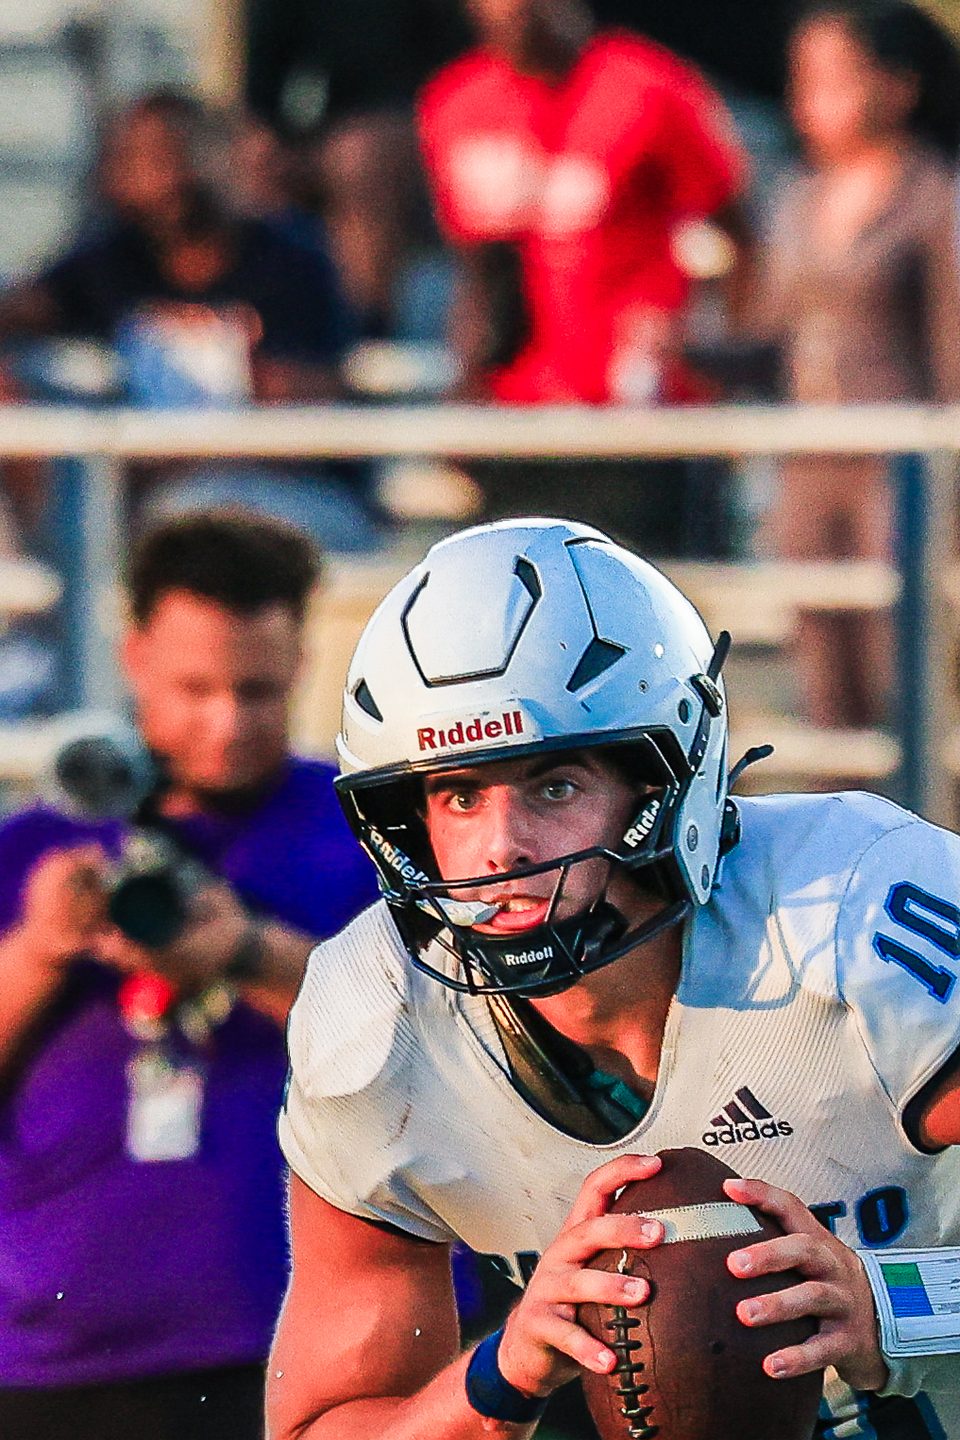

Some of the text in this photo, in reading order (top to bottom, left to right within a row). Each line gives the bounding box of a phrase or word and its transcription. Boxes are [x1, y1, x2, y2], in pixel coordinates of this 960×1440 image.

[417, 711, 524, 751] Riddell
[505, 946, 553, 966] Riddell
[702, 1120, 794, 1146] adidas
